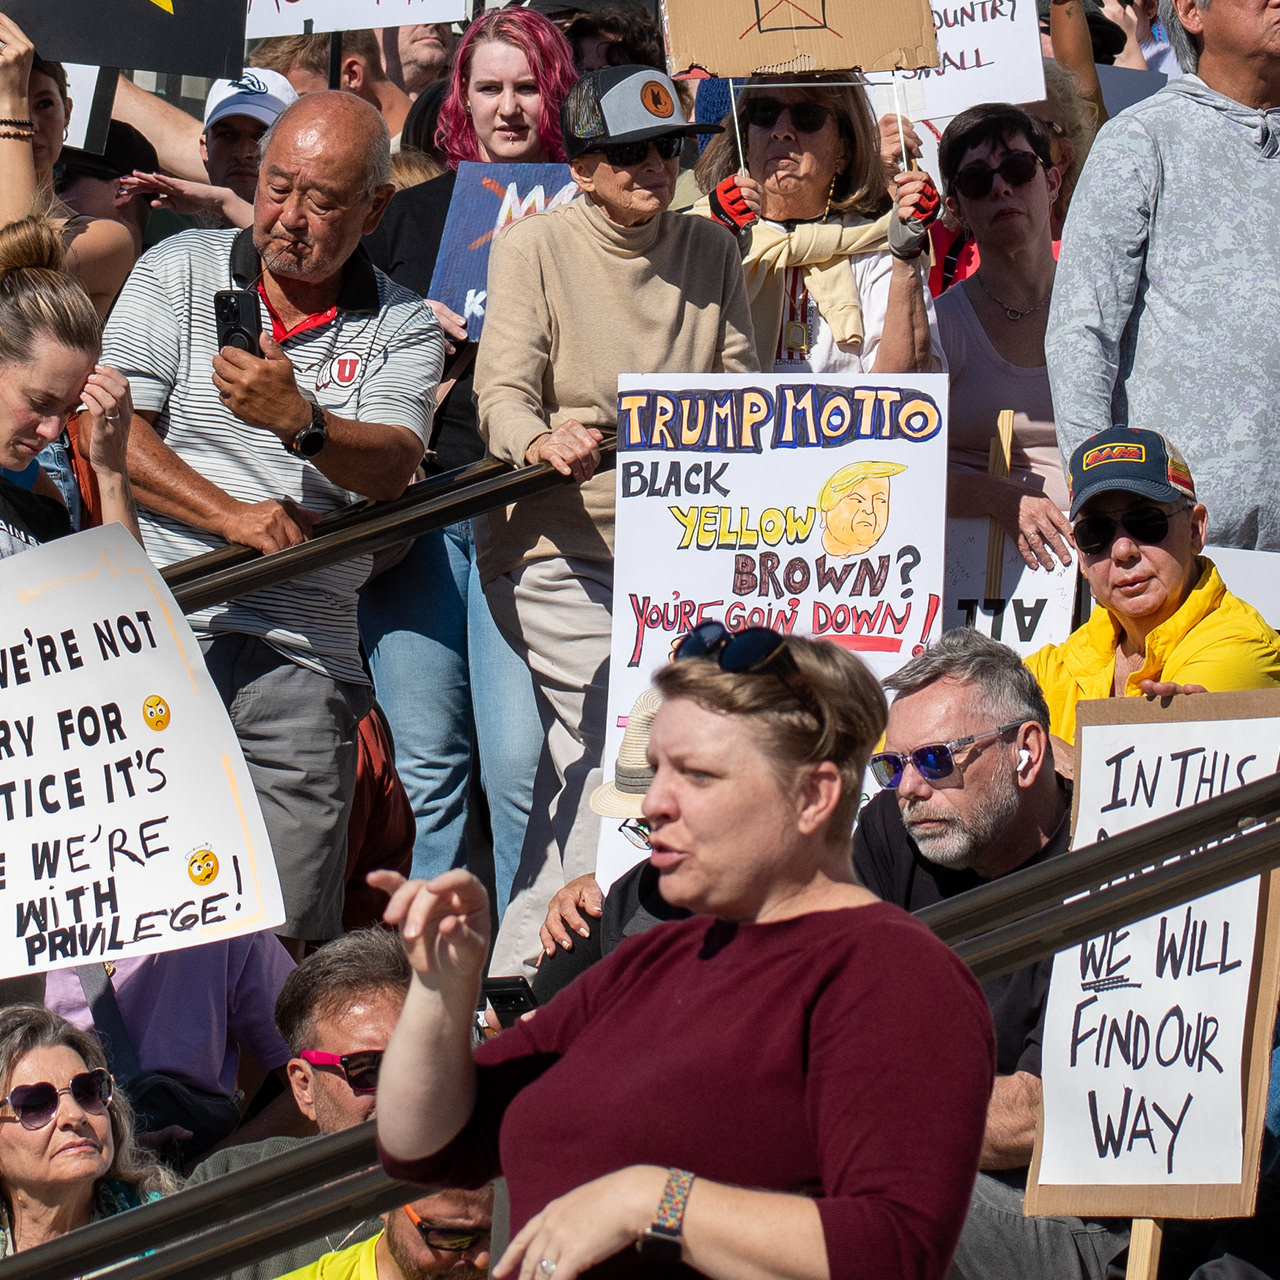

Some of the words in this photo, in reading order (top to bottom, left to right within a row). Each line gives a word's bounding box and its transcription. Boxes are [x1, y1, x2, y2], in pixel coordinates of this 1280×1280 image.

[618, 386, 773, 454] TRUMP
[773, 384, 941, 449] MOTTO
[621, 461, 731, 498] BLACK
[667, 504, 819, 550] YELLOW
[733, 545, 921, 599] BROWN?
[94, 610, 158, 662] NOT
[812, 594, 941, 657] DOWN!
[59, 701, 126, 751] FOR
[104, 747, 167, 804] IT'S
[1100, 744, 1165, 815] IN
[1171, 747, 1257, 807] THIS
[31, 816, 169, 882] WE'RE
[1079, 924, 1132, 977] WE
[1158, 906, 1242, 980] WILL
[1070, 995, 1149, 1070] FIND
[1156, 1005, 1223, 1073] OUR
[1087, 1083, 1194, 1174] WAY
